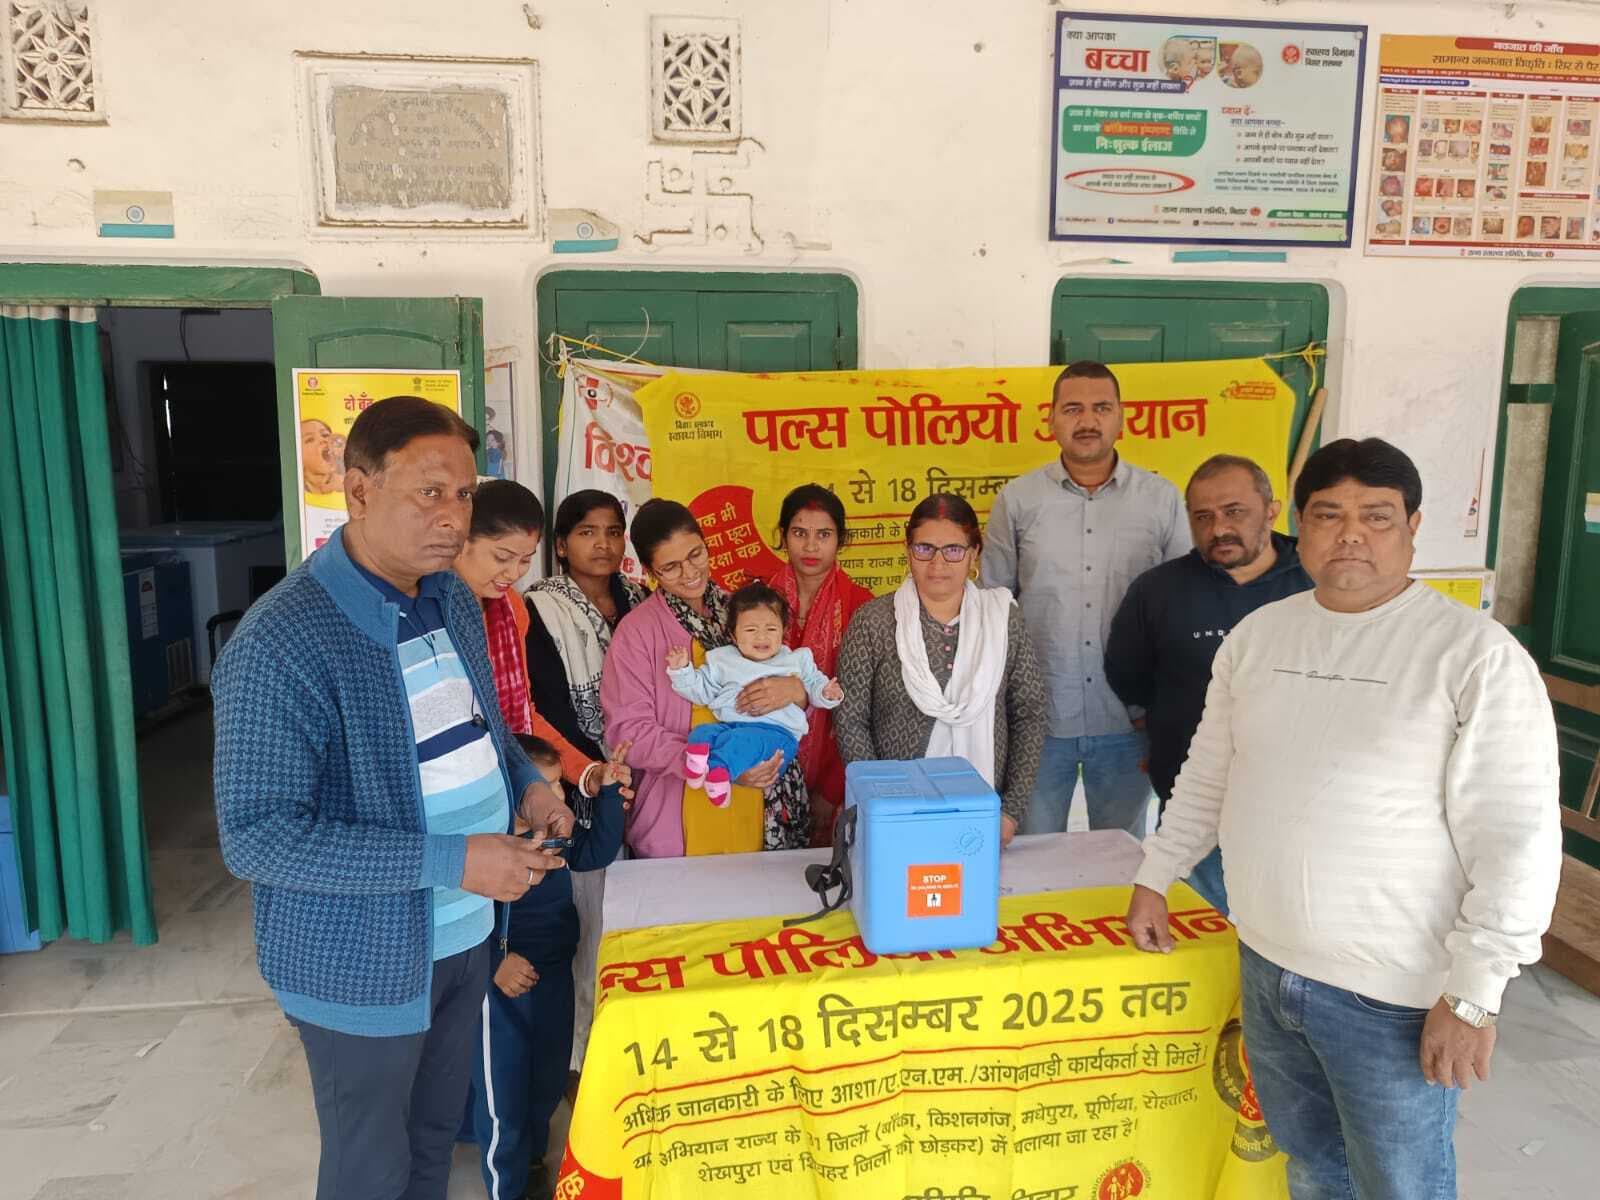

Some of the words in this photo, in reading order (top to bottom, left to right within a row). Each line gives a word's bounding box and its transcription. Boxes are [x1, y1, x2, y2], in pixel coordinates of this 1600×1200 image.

[1066, 31, 1082, 40] क्या
[1086, 31, 1116, 40] आपका
[1085, 48, 1150, 72] बच्चा
[344, 394, 356, 411] दो
[742, 405, 849, 452] पल्स
[860, 392, 1022, 447] पोलियो
[1034, 398, 1208, 443] अयान
[849, 469, 876, 503] से
[888, 478, 916, 503] 18
[721, 502, 737, 521] भी
[736, 541, 761, 559] चक्र
[922, 874, 947, 883] STOP
[624, 1037, 678, 1076] 14
[694, 1010, 739, 1063] से
[758, 1014, 804, 1053] 18
[817, 993, 983, 1048] दिसम्बर
[1002, 987, 1104, 1030] 2025
[1119, 981, 1191, 1018] तक
[623, 1102, 671, 1132] अधिक
[676, 1084, 760, 1117] जानकारी
[766, 1080, 785, 1103] के
[790, 1075, 824, 1109] लिए
[1068, 1044, 1139, 1074] कार्यकर्ता
[1142, 1044, 1161, 1067] से
[659, 1140, 729, 1167] अभियान
[734, 1133, 777, 1151] राज्य
[784, 1124, 801, 1145] के
[827, 1124, 870, 1152] जिलों
[928, 1107, 1017, 1132] किशनगंज,
[1021, 1102, 1078, 1125] मधेपुरा,
[698, 1161, 762, 1185] शेखपुरा
[769, 1154, 793, 1175] एवं
[799, 1151, 850, 1182] शिवहर
[853, 1144, 892, 1177] जिलों
[919, 1134, 984, 1157] छोड़कर)
[990, 1133, 1009, 1156] में
[1066, 1128, 1087, 1144] जा
[1091, 1125, 1118, 1141] रहा
